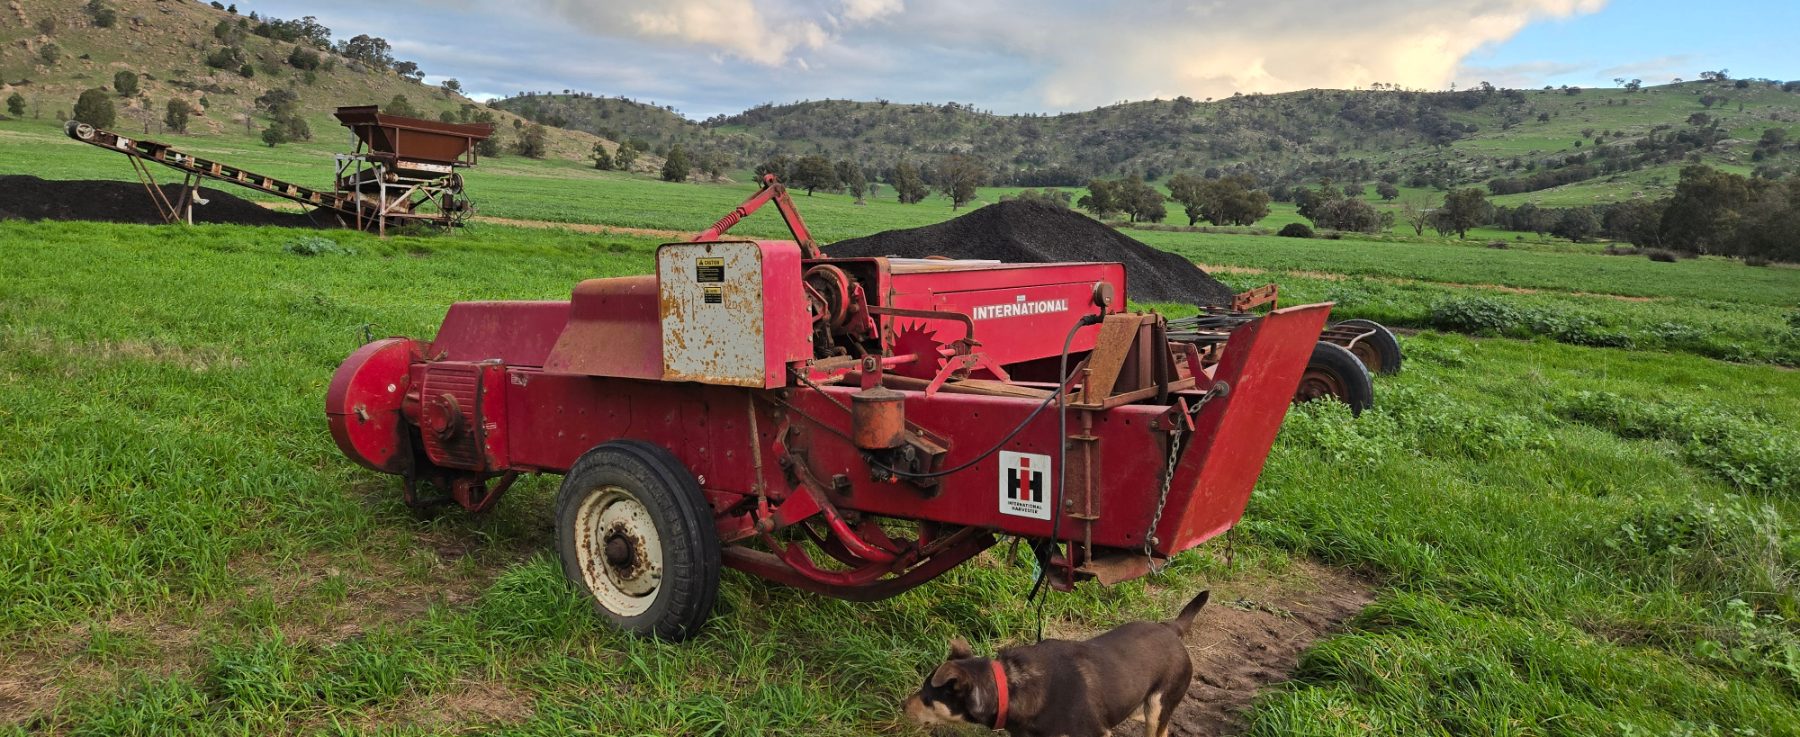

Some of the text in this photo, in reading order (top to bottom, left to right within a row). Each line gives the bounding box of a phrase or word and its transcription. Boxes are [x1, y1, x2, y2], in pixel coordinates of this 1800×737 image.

[973, 299, 1068, 320] INTERNATIONAL
[1008, 501, 1042, 510] INTERNATIONAL
[1012, 506, 1039, 514] HARVESTER
